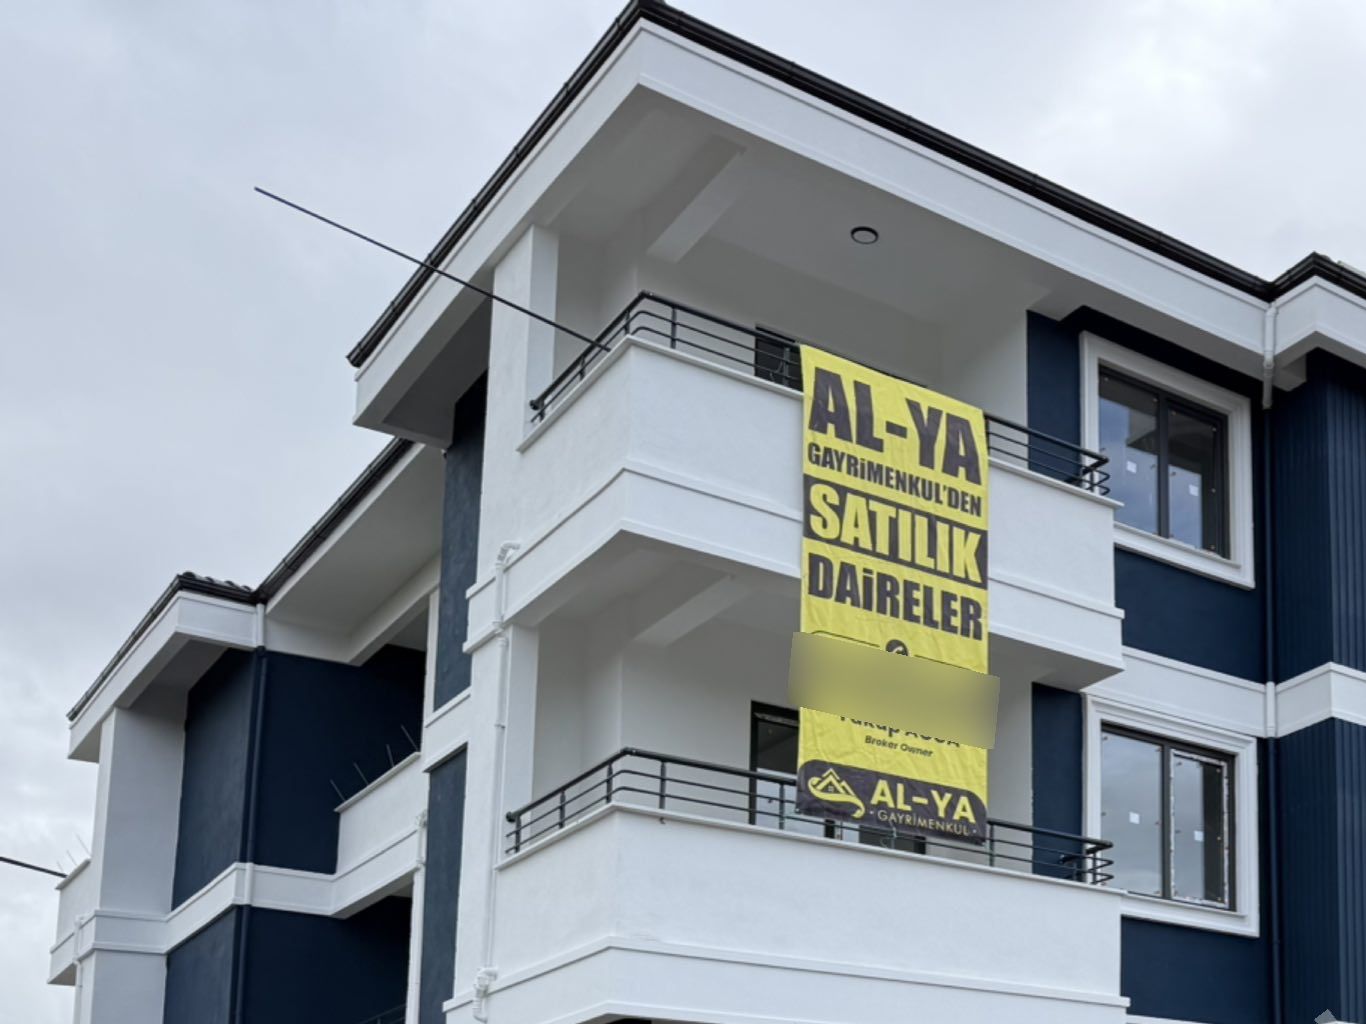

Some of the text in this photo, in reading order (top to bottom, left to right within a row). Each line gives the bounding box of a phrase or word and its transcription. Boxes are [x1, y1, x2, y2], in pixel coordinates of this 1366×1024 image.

[808, 366, 982, 486] AL-YA
[809, 483, 982, 584] SATILIK
[864, 735, 898, 750] Broker
[900, 743, 934, 757] Owner
[870, 779, 976, 824] AL-YA
